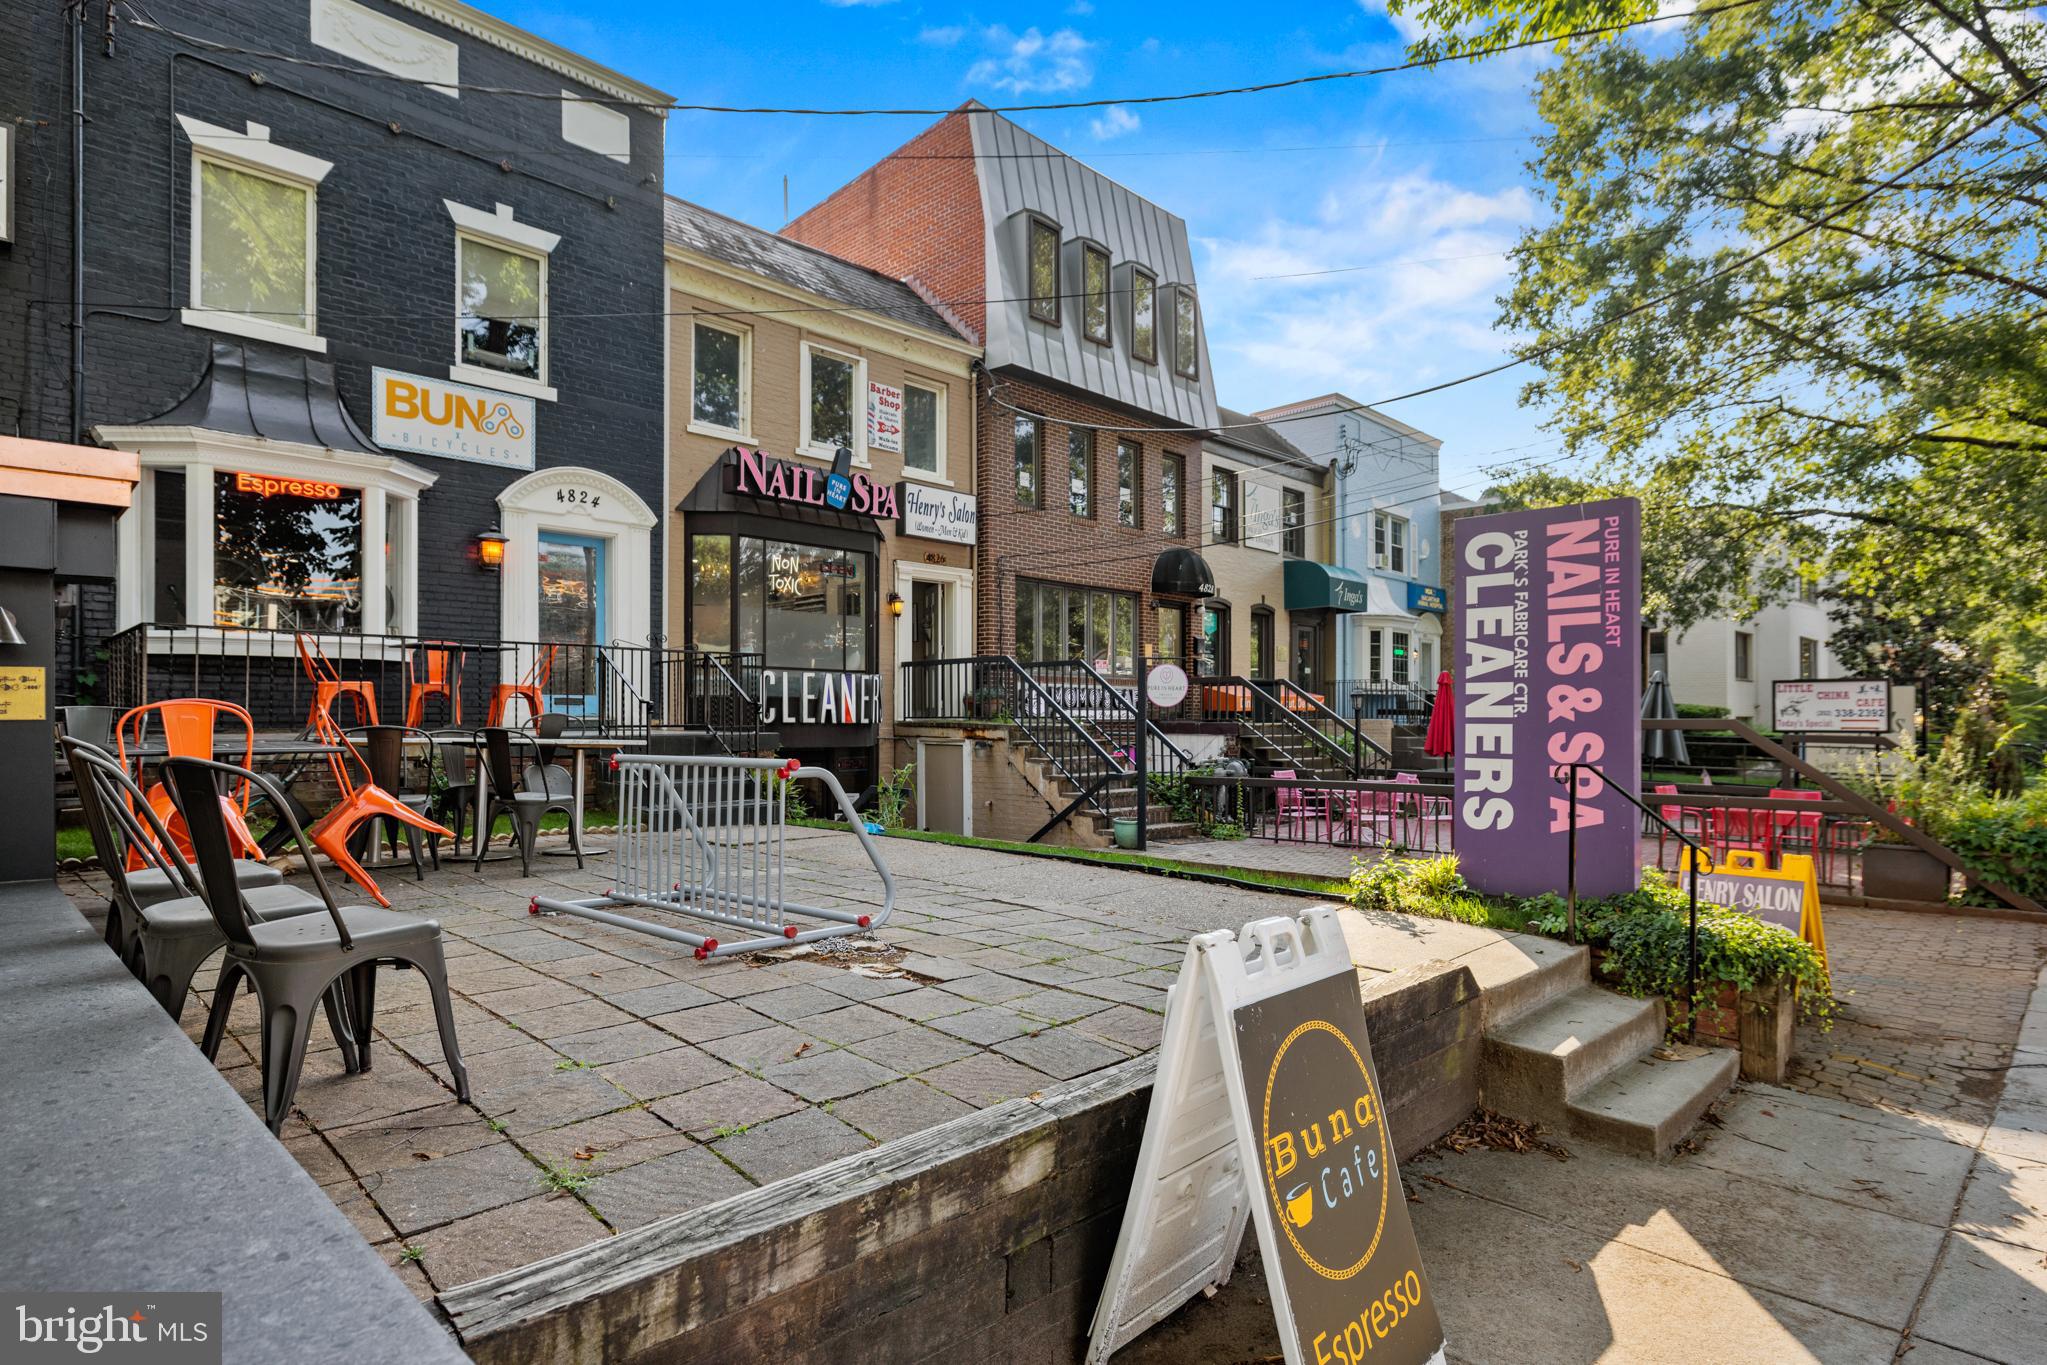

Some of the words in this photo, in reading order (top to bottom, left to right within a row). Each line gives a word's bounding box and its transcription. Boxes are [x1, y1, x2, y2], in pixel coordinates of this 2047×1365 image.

[870, 382, 901, 399] Barber
[879, 396, 901, 411] Shop
[402, 432, 510, 459] BICYCLES
[236, 472, 340, 498] Espresso
[736, 446, 824, 507] NAIL
[831, 479, 847, 491] PURE
[833, 486, 841, 494] IN
[557, 489, 600, 508] 4824
[826, 489, 847, 504] HEART
[907, 489, 945, 525] Henry's
[948, 495, 976, 524] Salon
[1604, 515, 1620, 563] PURE
[1604, 566, 1620, 585] IN
[1344, 587, 1364, 607] Inga's
[1546, 518, 1604, 676] NAILS
[1604, 590, 1621, 648] HEART
[1513, 590, 1529, 680] FABRICARE
[1462, 531, 1516, 831] CLEANERS
[1776, 684, 1814, 693] LITTLE
[1816, 691, 1850, 700] CHINA
[1513, 683, 1529, 718] CTR.
[1547, 684, 1603, 723] &
[1856, 698, 1886, 708] CAFE
[1547, 731, 1605, 834] SPA
[1743, 883, 1802, 912] SALON
[1268, 1094, 1376, 1179] Buna
[1321, 1144, 1380, 1209] Cafe
[1311, 1270, 1422, 1365] Espresso
